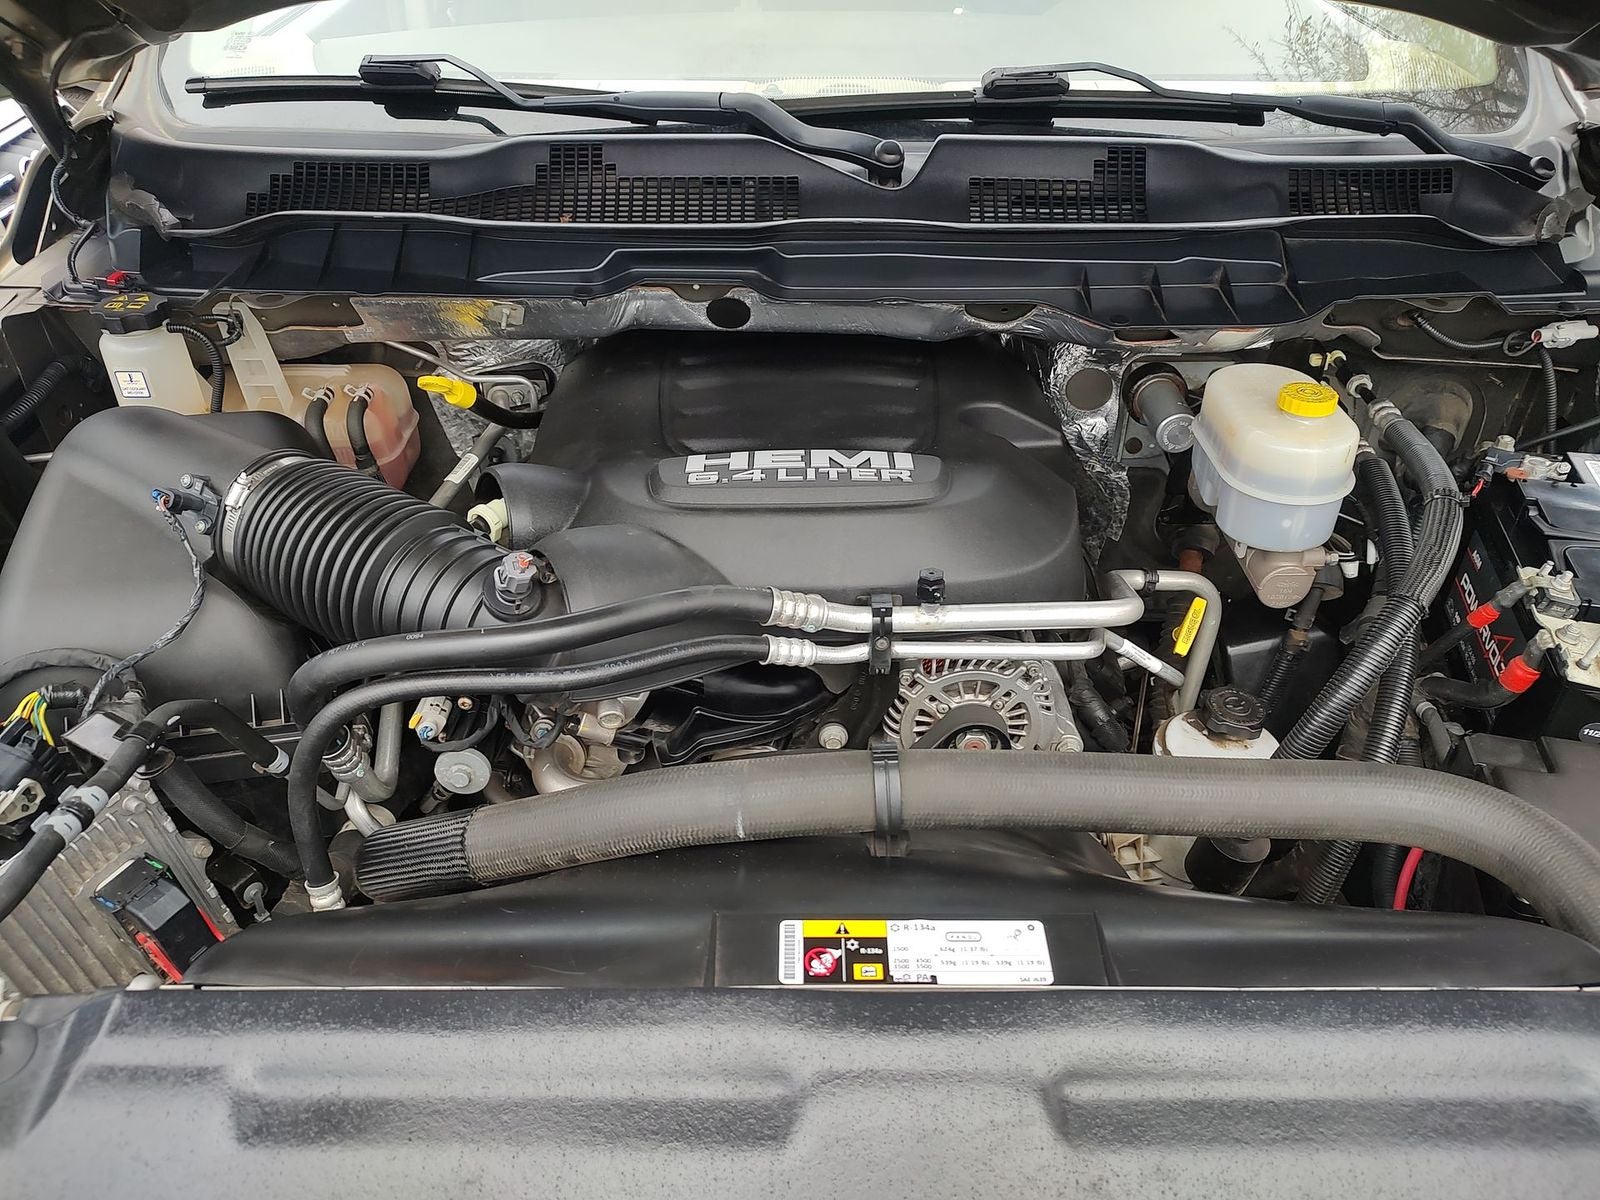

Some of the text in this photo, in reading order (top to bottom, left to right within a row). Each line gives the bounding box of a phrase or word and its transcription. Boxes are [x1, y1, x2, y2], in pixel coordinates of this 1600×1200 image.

[684, 449, 916, 473] HEMI
[686, 467, 914, 486] 6.4 LITER
